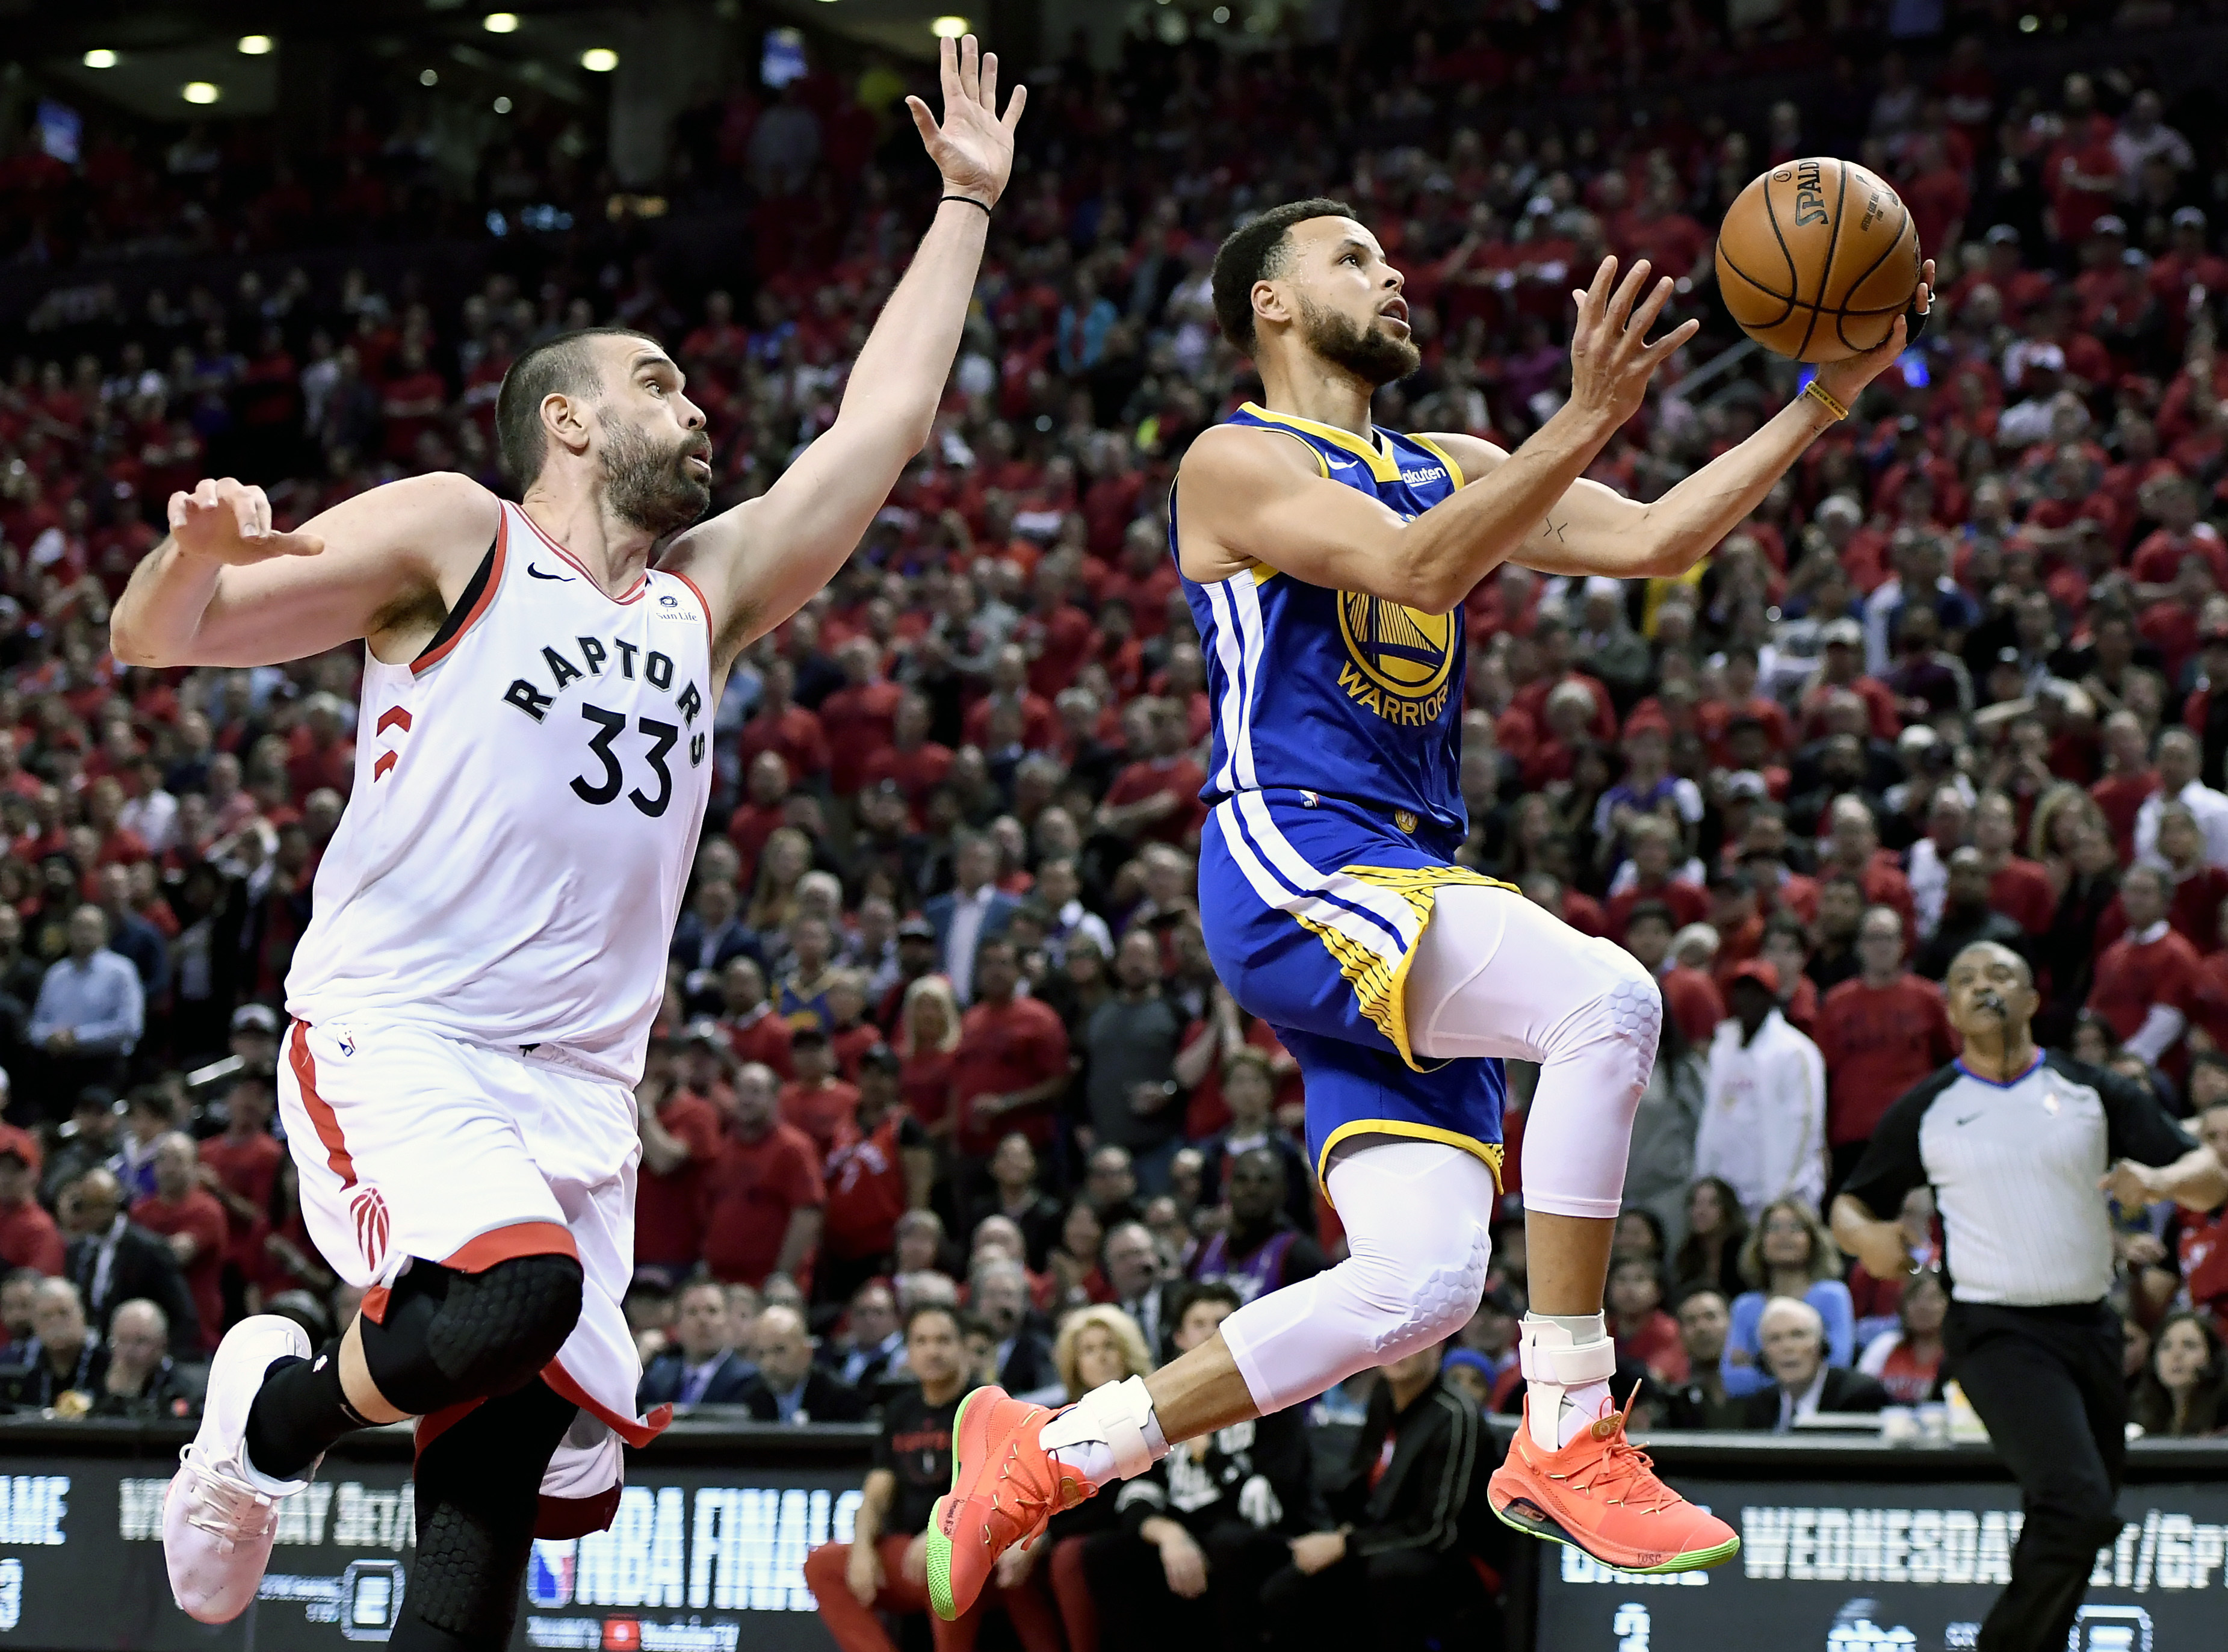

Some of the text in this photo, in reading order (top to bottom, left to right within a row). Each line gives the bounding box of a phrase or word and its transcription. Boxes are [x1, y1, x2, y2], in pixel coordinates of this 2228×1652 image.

[1402, 466, 1447, 484] akuten
[678, 611, 698, 622] Life
[501, 636, 705, 769] RAPTORS
[1337, 660, 1449, 726] WARRIOR
[569, 702, 679, 818] 33
[575, 1485, 685, 1607] NBA
